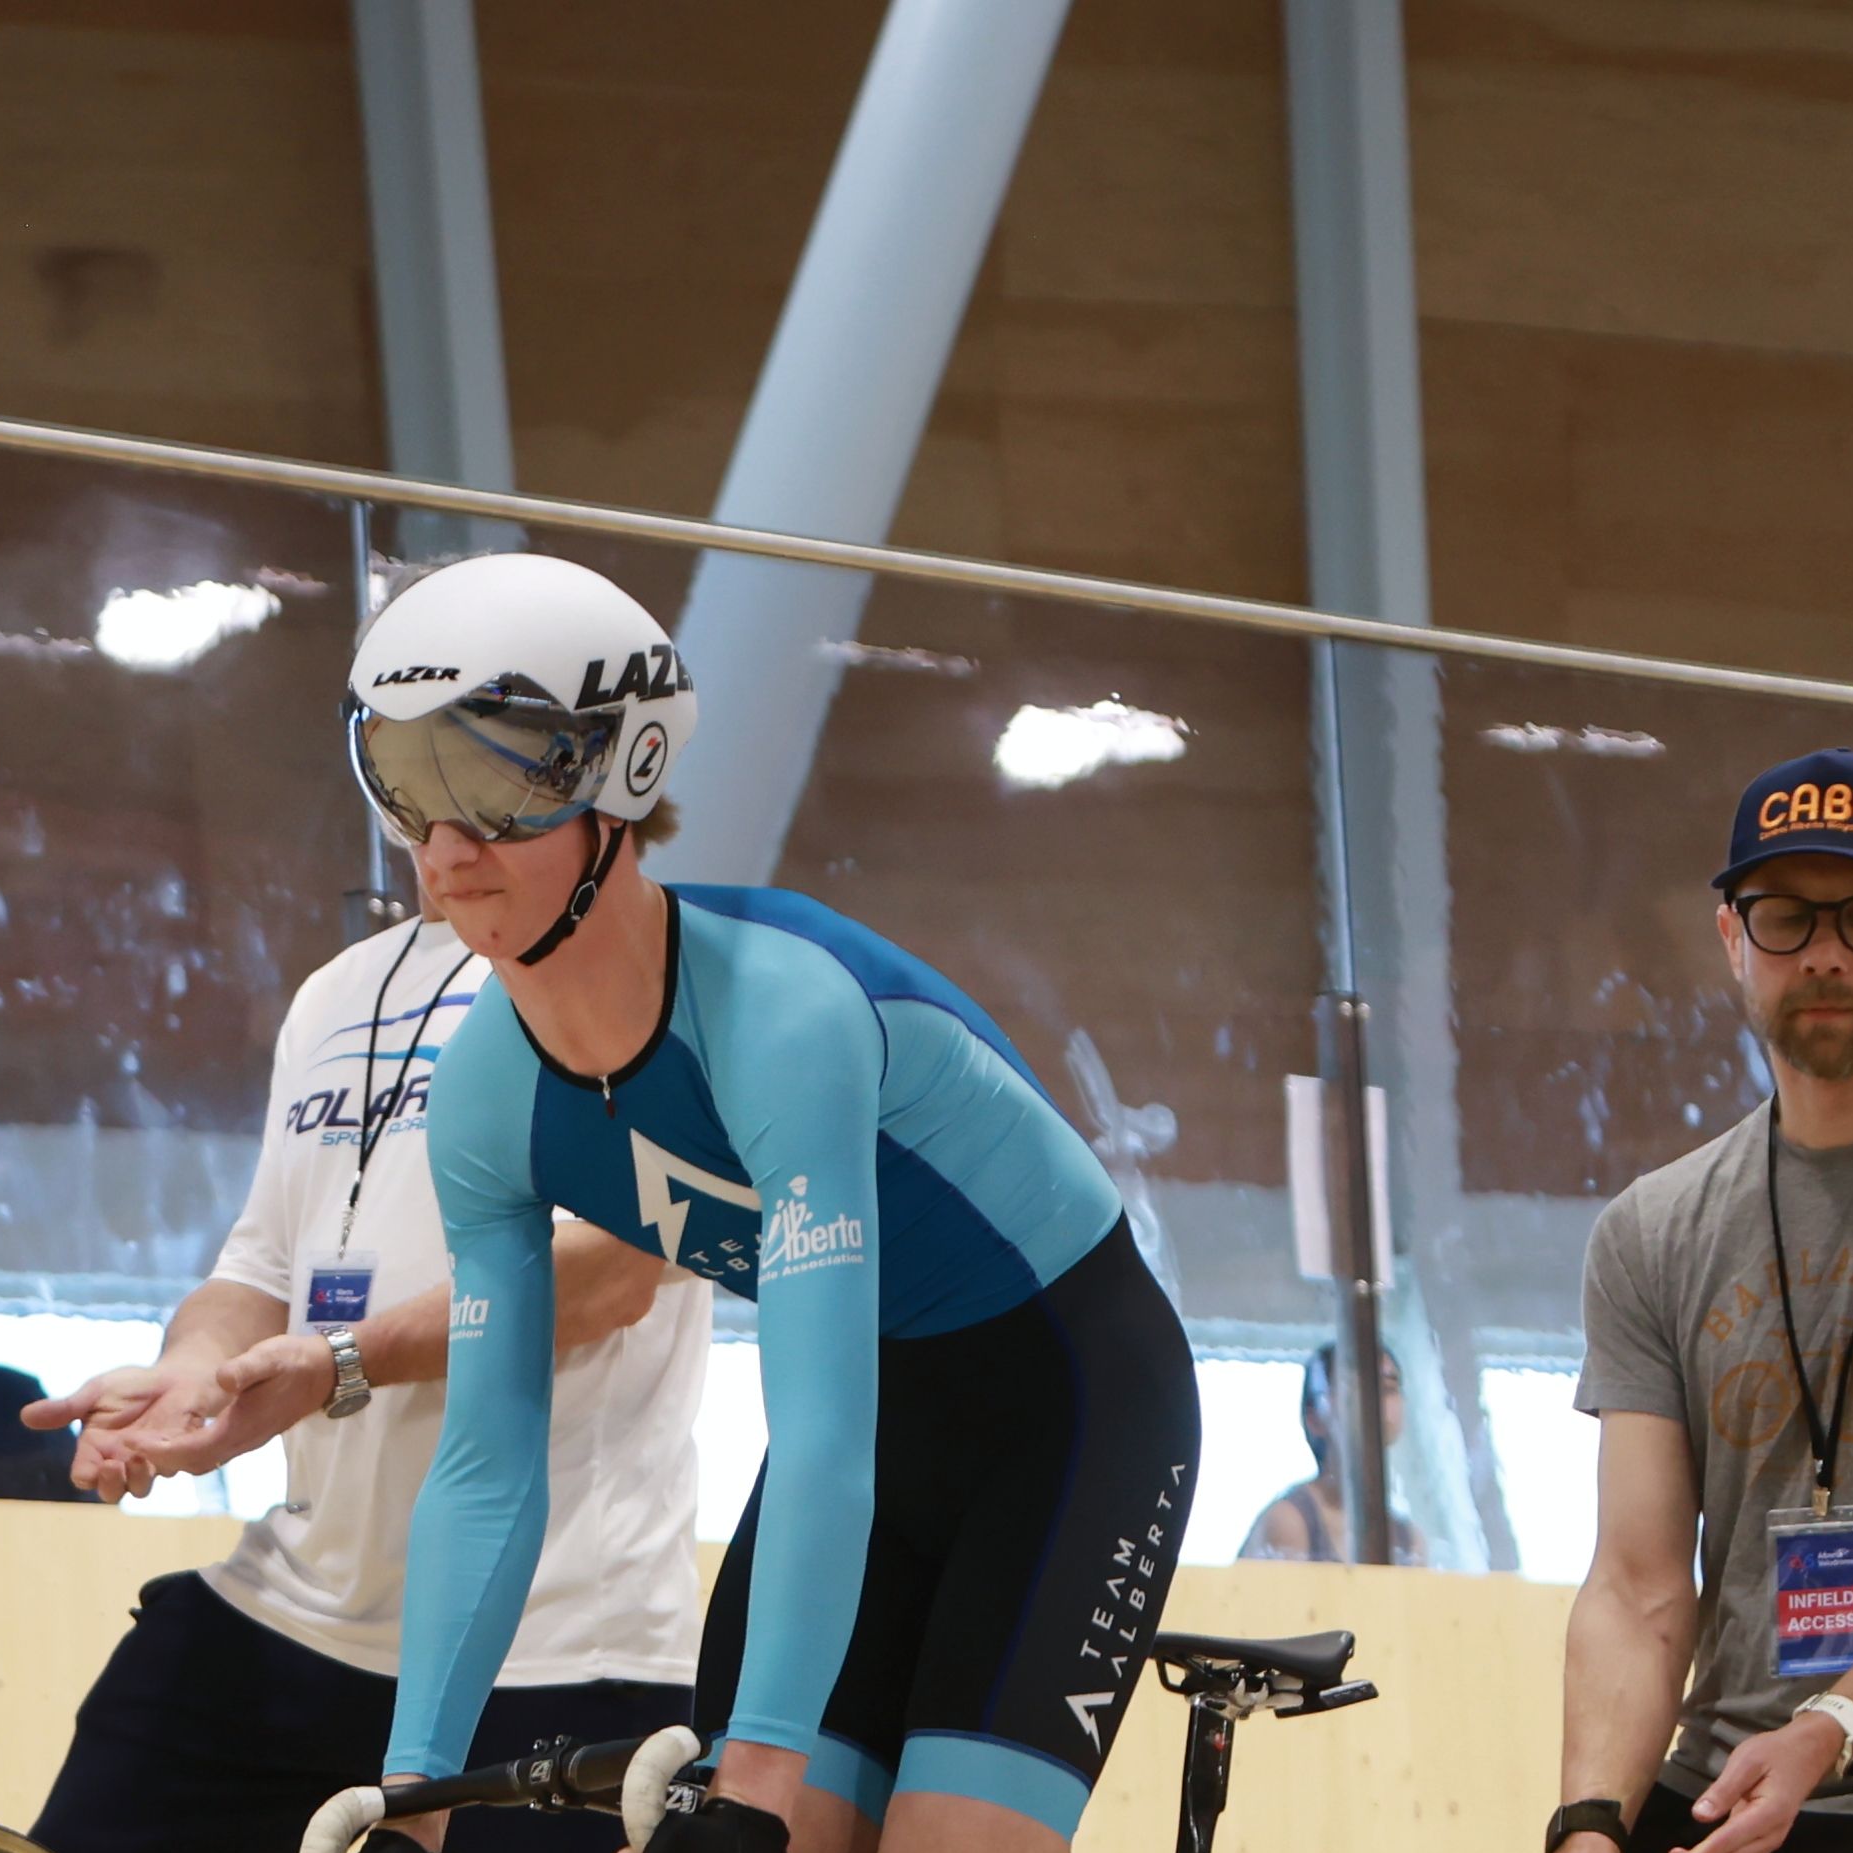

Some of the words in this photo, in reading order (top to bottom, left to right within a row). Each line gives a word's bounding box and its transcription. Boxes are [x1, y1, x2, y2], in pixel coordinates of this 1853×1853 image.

[372, 664, 462, 688] LAZER
[1079, 1536, 1137, 1660] TEAM
[1110, 1462, 1186, 1679] ALBERTA
